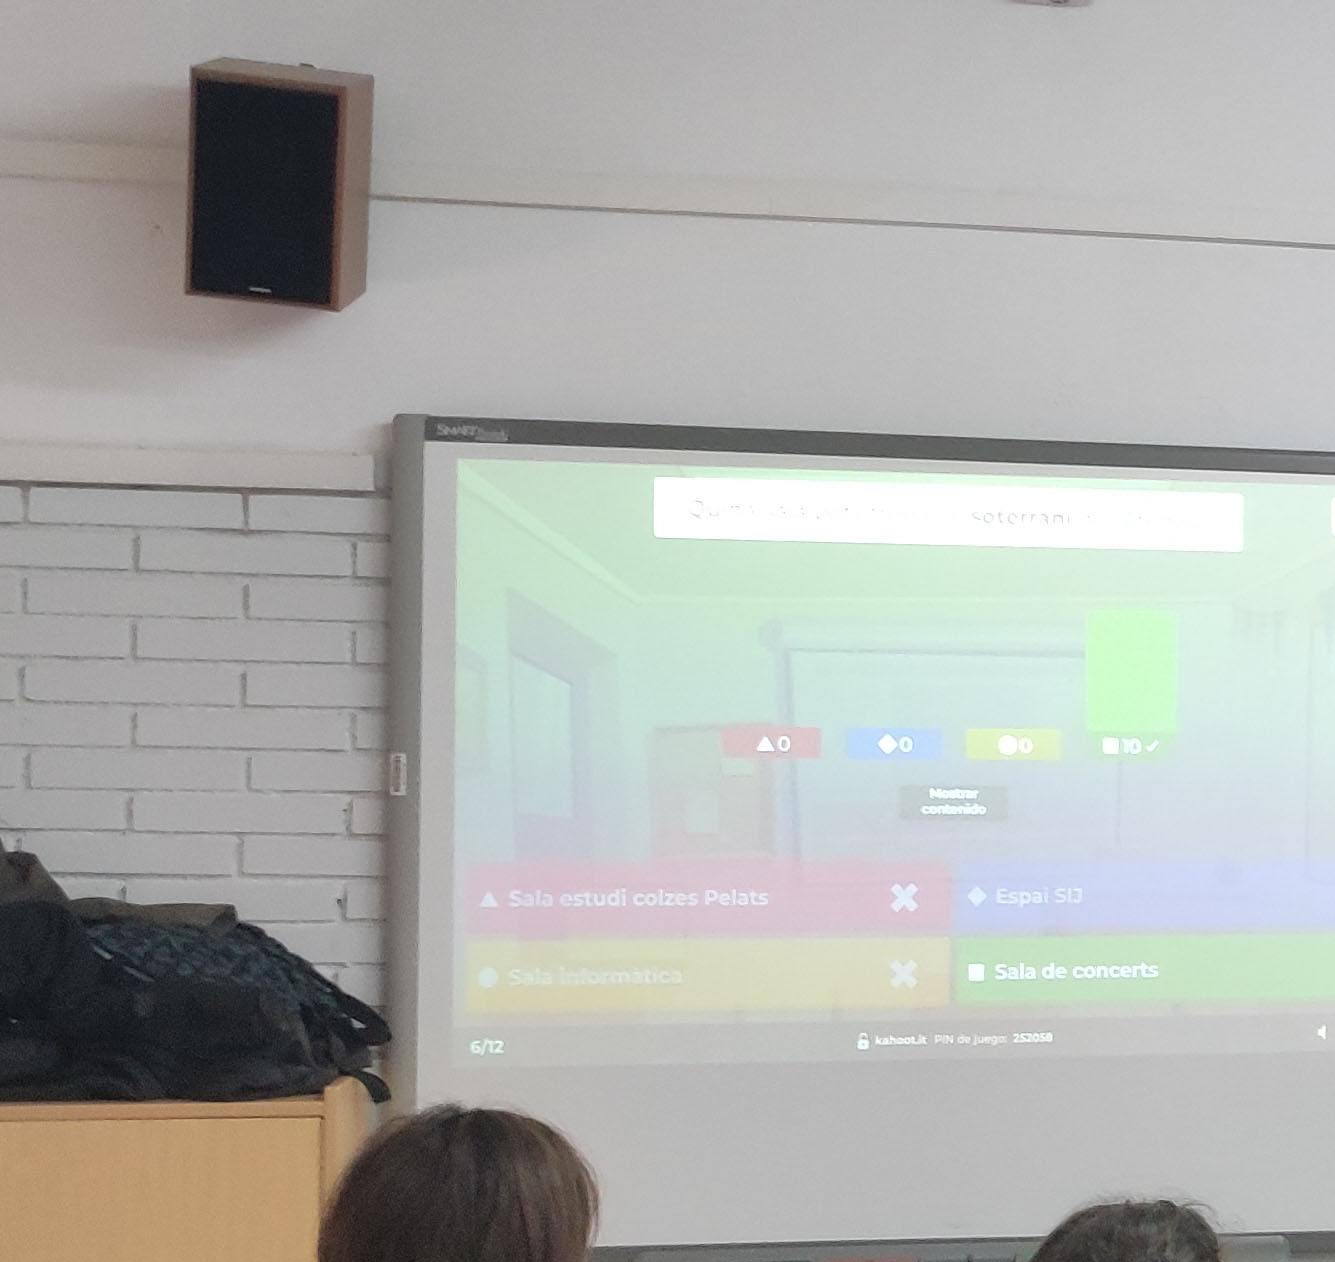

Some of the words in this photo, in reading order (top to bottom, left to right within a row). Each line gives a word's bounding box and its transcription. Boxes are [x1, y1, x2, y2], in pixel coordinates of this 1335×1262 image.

[920, 802, 987, 816] contenido
[508, 889, 554, 908] Sala
[560, 888, 627, 908] estudi
[632, 888, 698, 907] colzes
[704, 888, 769, 907] Pelats
[995, 886, 1049, 908] Espai
[1054, 887, 1084, 904] SIJ
[508, 967, 553, 986] Sala
[994, 962, 1037, 981] Sala
[1041, 962, 1068, 980] de
[1071, 962, 1161, 980] concerts
[468, 1038, 504, 1056] 6/12
[874, 1034, 929, 1046] kahoot.it
[933, 1033, 954, 1045] PIN
[956, 1033, 971, 1045] de
